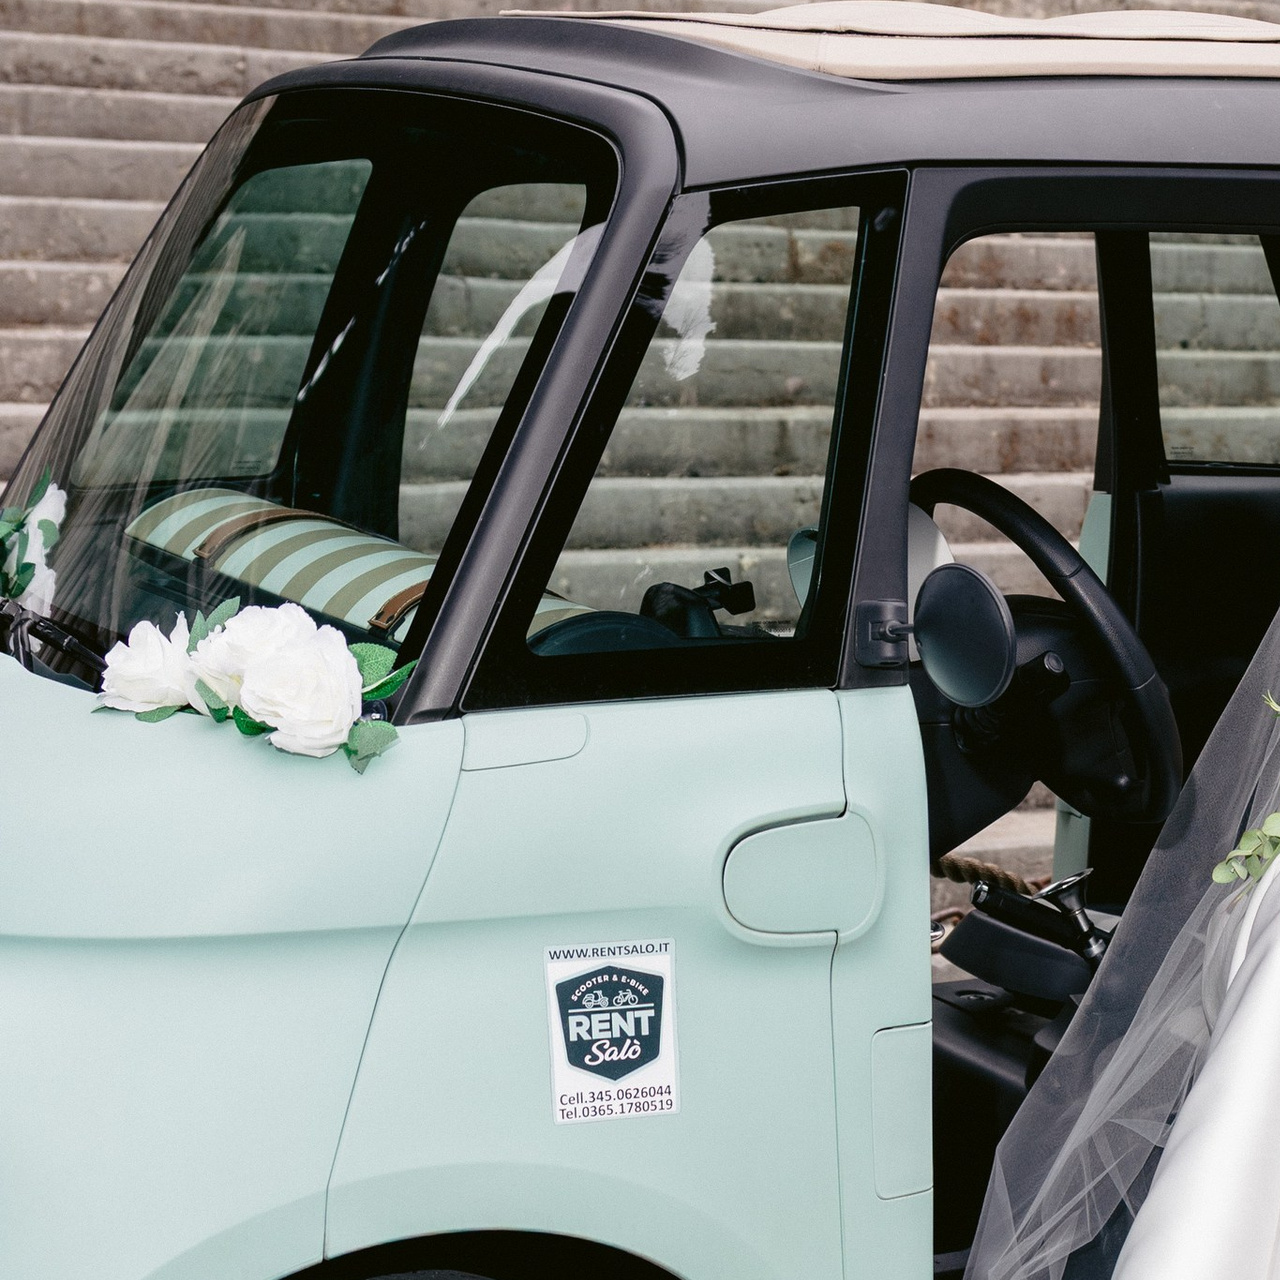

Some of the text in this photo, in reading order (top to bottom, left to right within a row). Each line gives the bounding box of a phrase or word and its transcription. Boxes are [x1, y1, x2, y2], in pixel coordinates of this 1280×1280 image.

[548, 942, 670, 960] WWW.RENTSALO.IT
[570, 974, 610, 1002] SCOOTER
[612, 974, 618, 982] &
[567, 1009, 656, 1042] RENT
[584, 1039, 642, 1066] Salò
[560, 1084, 672, 1107] Cell.345.0626044
[559, 1098, 673, 1121] Tel.0365.1780519
